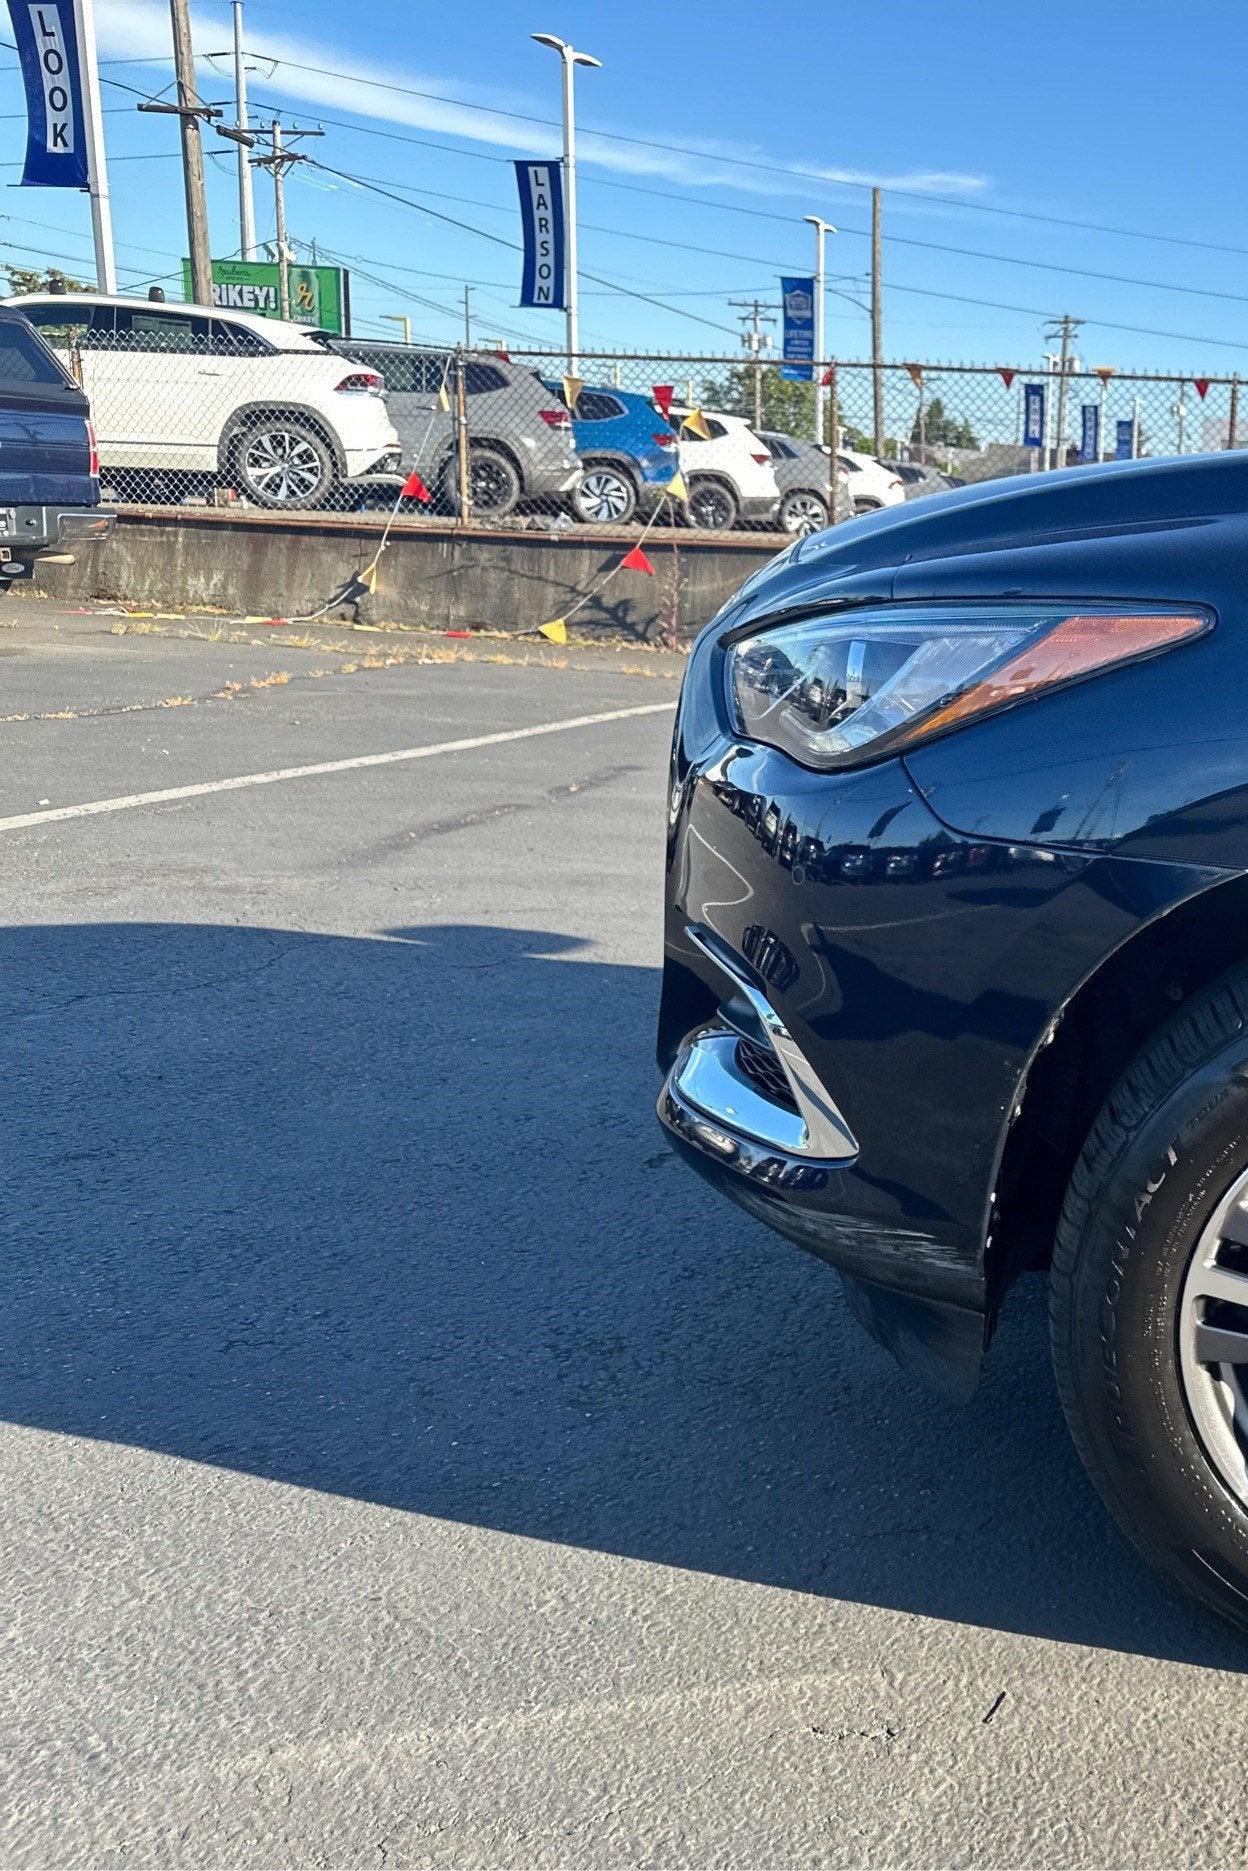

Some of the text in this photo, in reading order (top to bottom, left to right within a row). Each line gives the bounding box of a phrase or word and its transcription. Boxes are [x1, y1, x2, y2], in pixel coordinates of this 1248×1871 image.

[37, 10, 69, 148] LOOK
[212, 284, 278, 310] RIKEY!
[533, 169, 551, 301] LARSON
